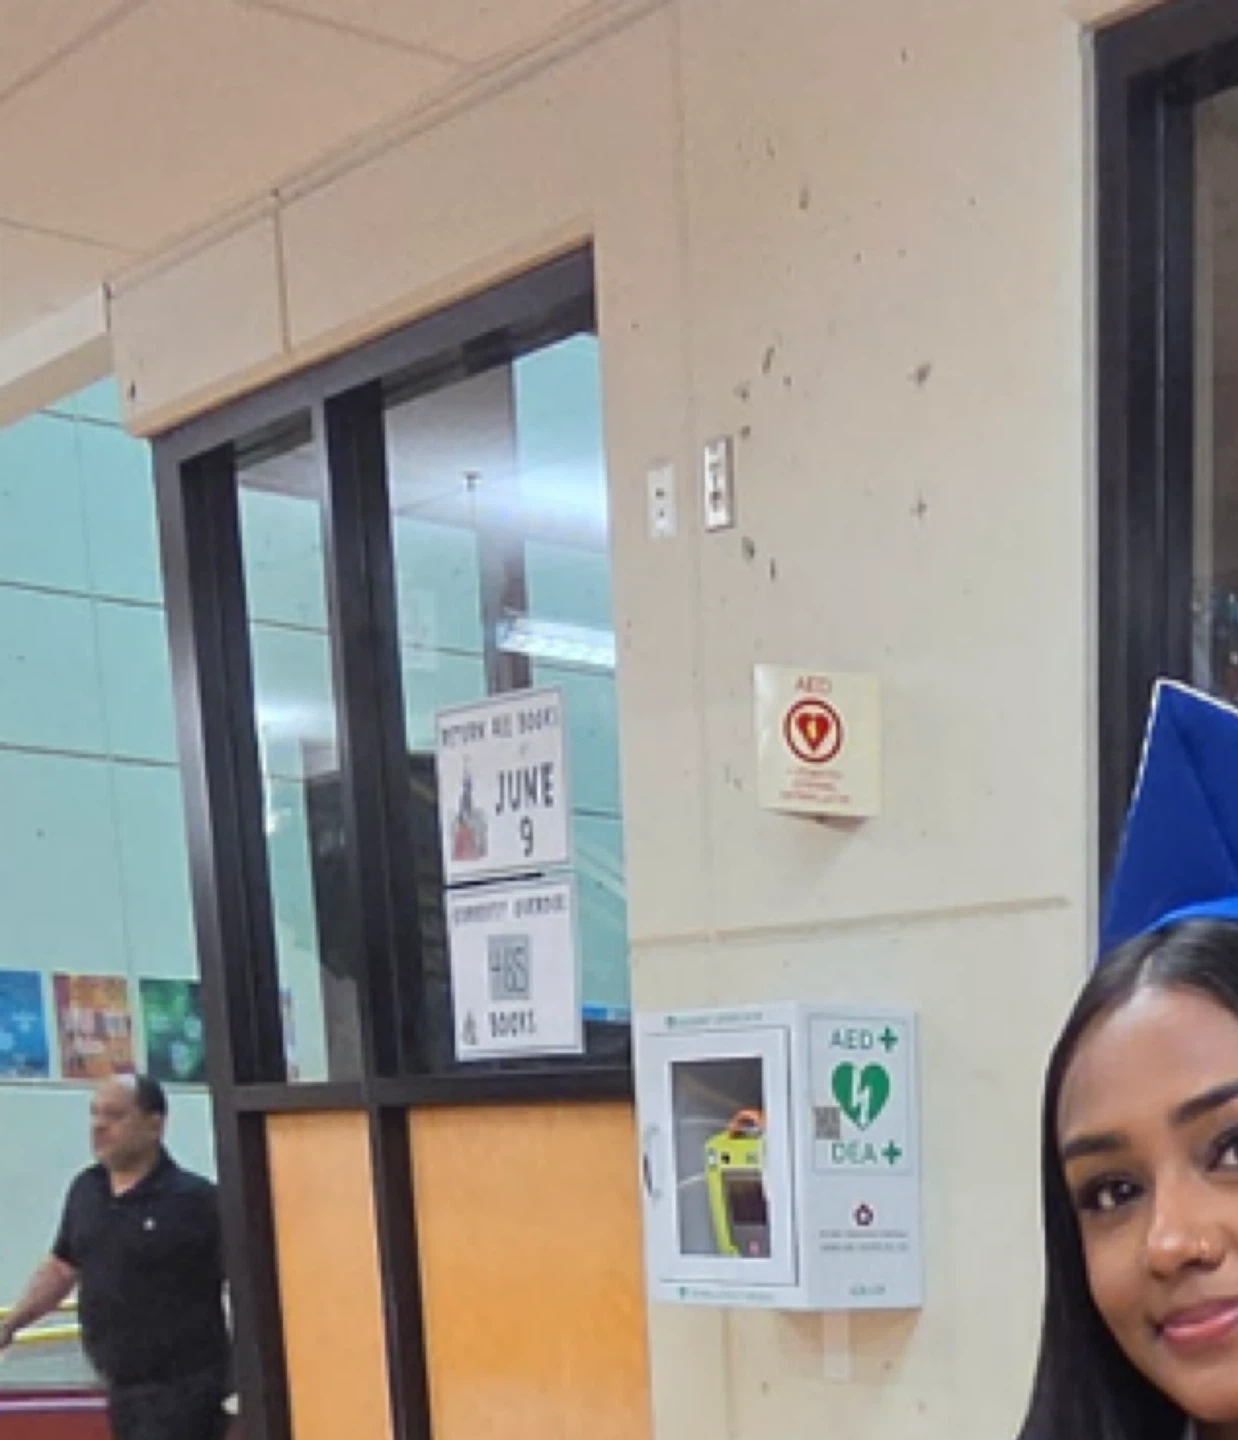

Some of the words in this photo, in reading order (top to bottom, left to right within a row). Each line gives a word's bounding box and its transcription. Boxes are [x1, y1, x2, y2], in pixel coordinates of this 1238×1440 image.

[794, 675, 832, 693] AED
[495, 761, 553, 816] JUNE
[520, 815, 533, 857] 9
